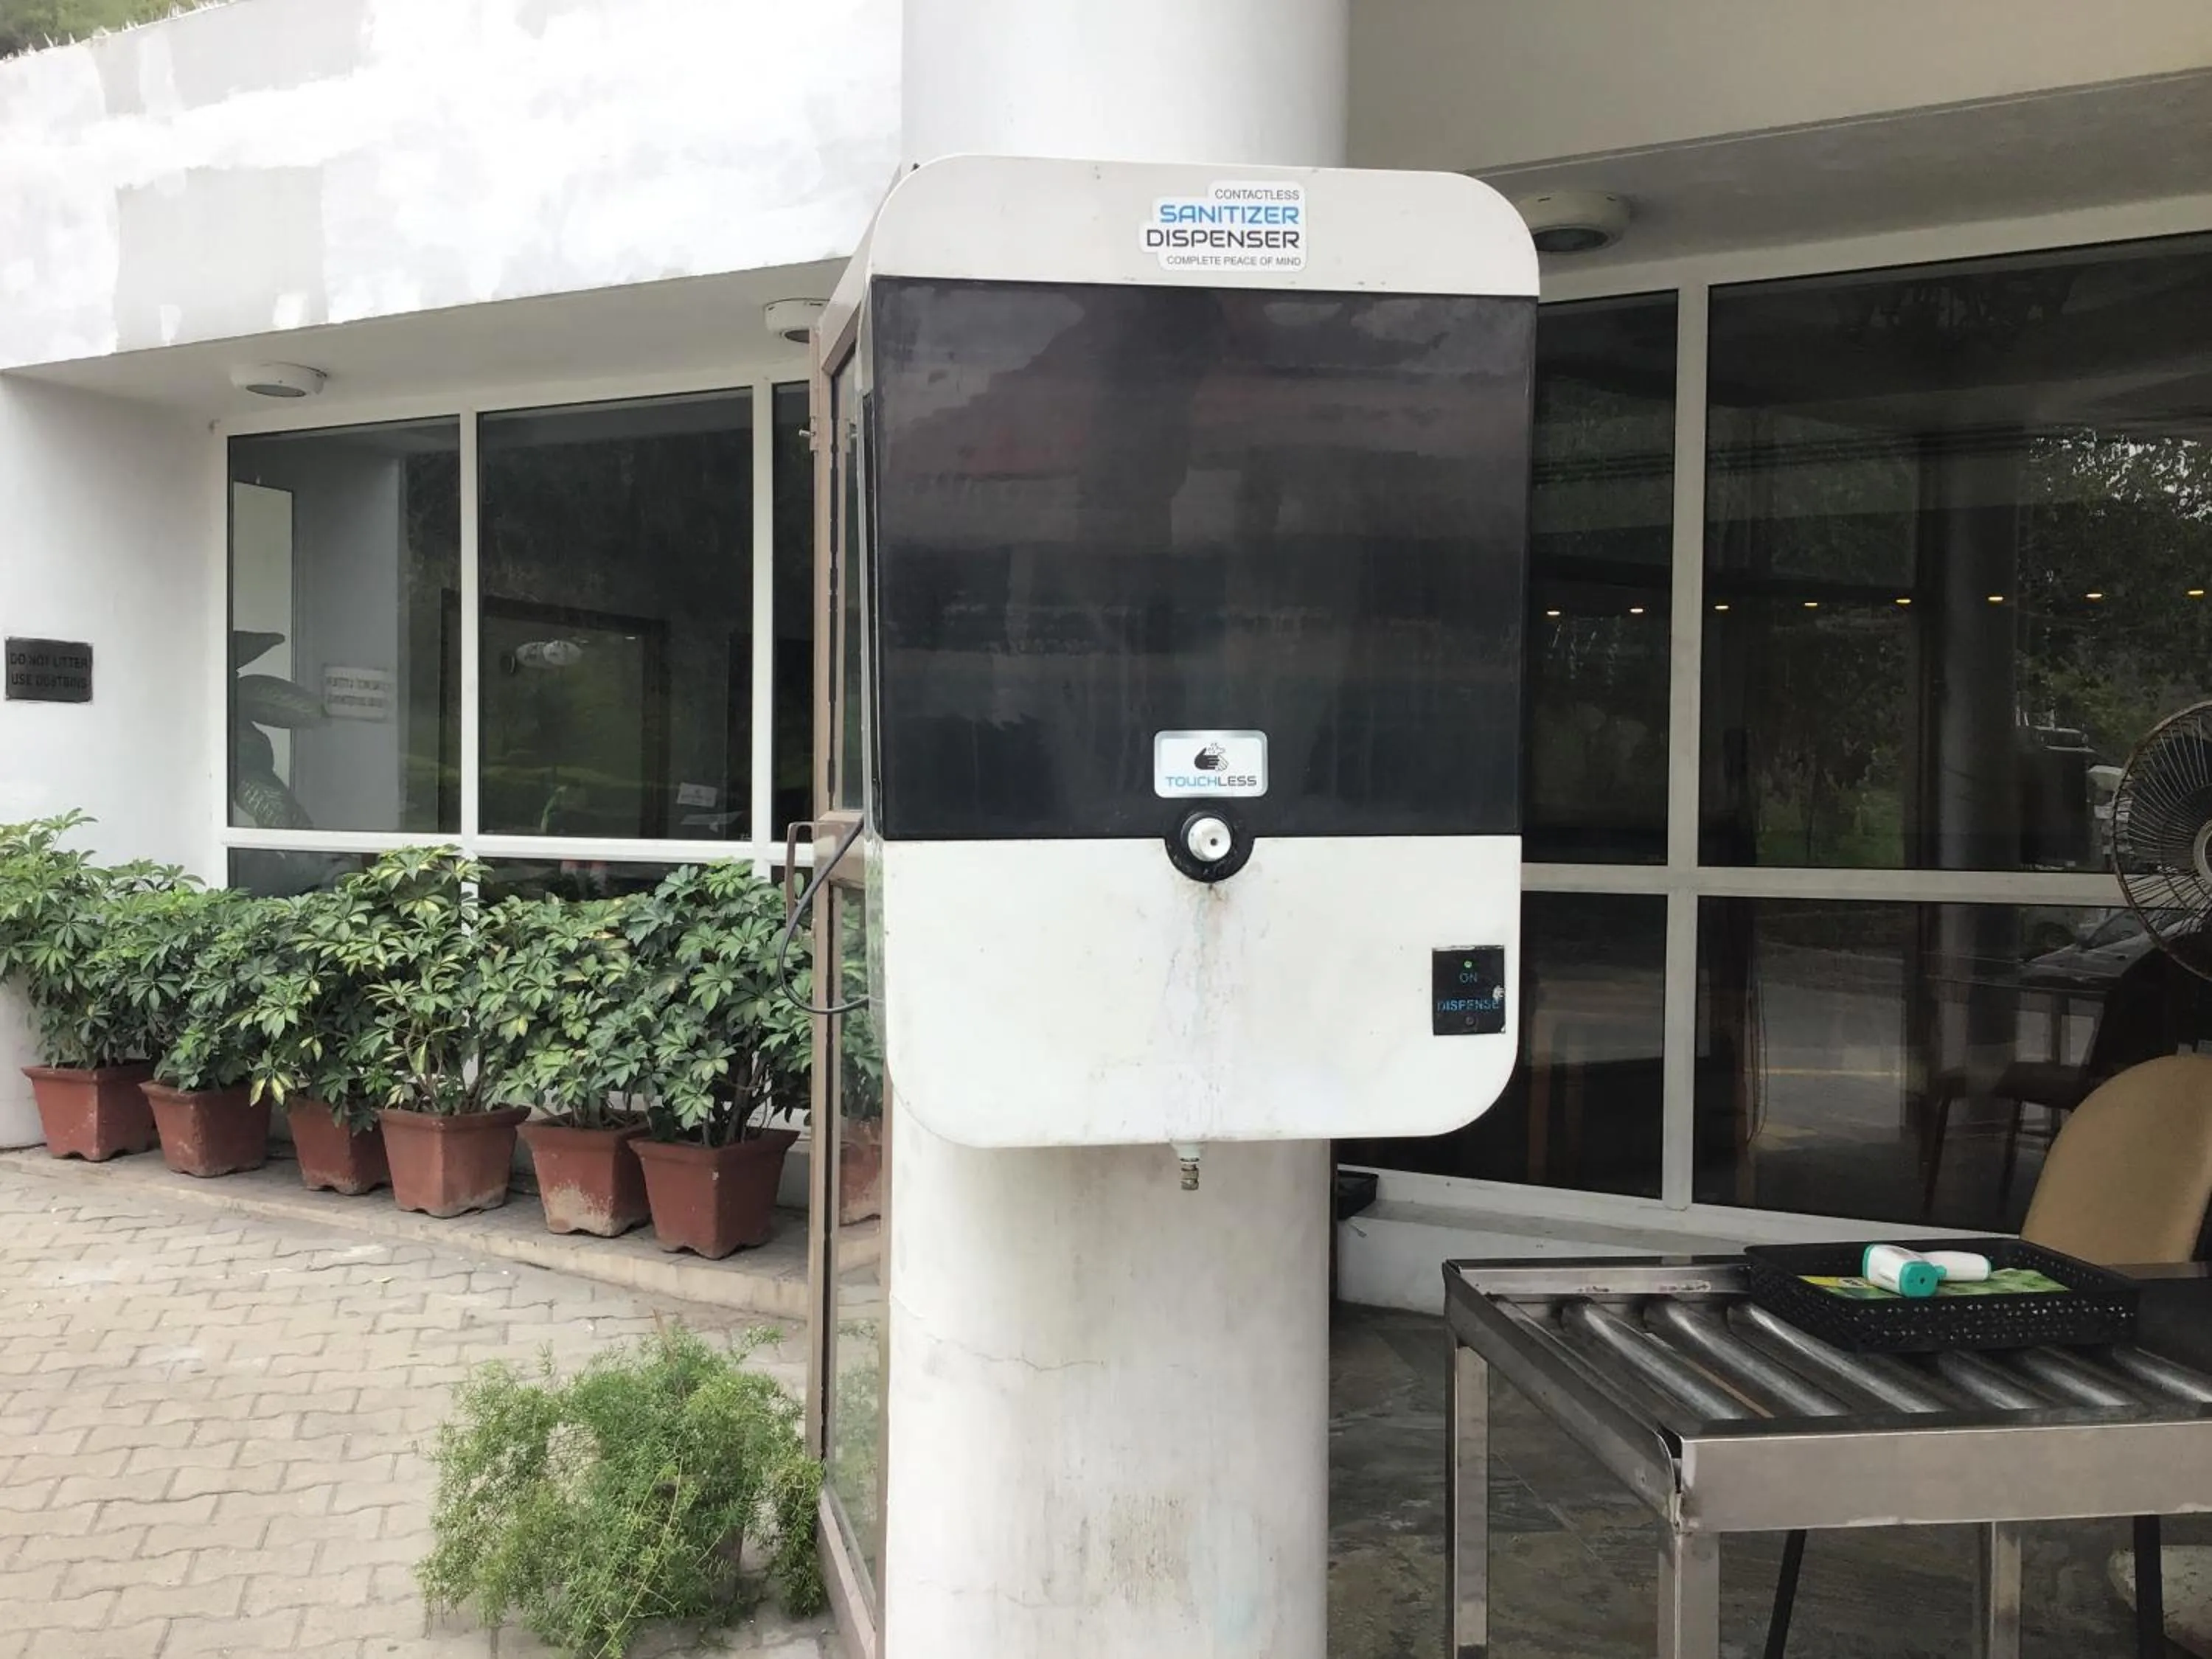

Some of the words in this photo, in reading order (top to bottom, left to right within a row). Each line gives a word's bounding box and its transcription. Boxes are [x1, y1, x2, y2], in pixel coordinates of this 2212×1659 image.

[1214, 189, 1300, 201] CONTACTLESS
[1160, 204, 1299, 224] SANITIZER
[1147, 229, 1300, 248] DISPENSER
[1167, 255, 1222, 265] COMPLETE
[1224, 256, 1259, 266] PEACE
[1259, 256, 1273, 266] OF
[1276, 256, 1301, 266] MIND
[11, 672, 32, 686] USE
[1165, 775, 1257, 787] TOUCHLESS
[1459, 972, 1478, 984] ON
[1436, 998, 1500, 1012] DISPENSE
